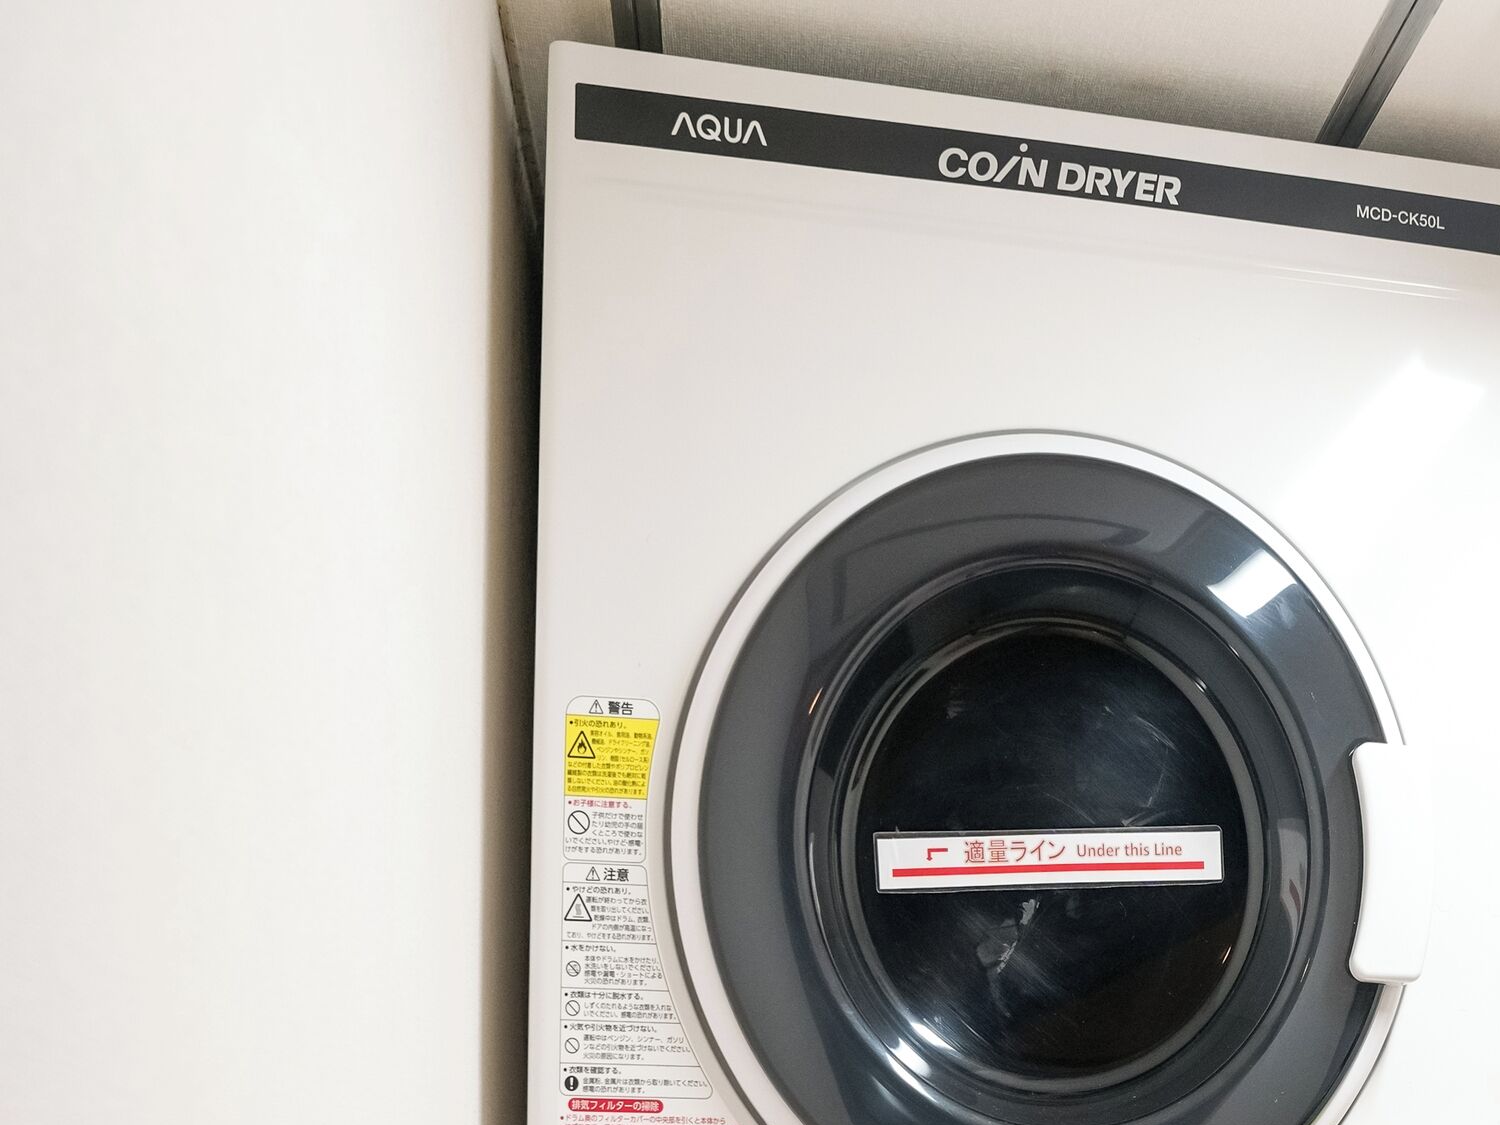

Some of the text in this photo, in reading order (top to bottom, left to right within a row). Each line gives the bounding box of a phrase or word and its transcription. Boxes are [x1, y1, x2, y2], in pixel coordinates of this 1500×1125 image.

[670, 112, 767, 146] AQUA
[938, 143, 1181, 206] COIN DRYER
[1356, 204, 1445, 230] MCD-CK50L
[608, 701, 633, 715] 警告
[964, 840, 1182, 863] 適量ライン Under this Line
[604, 868, 629, 882] 注意
[571, 944, 616, 952] 水をかけない。
[569, 1066, 621, 1074] 衣類を確認する。
[572, 1100, 660, 1112] 排気フィルターの掃除
